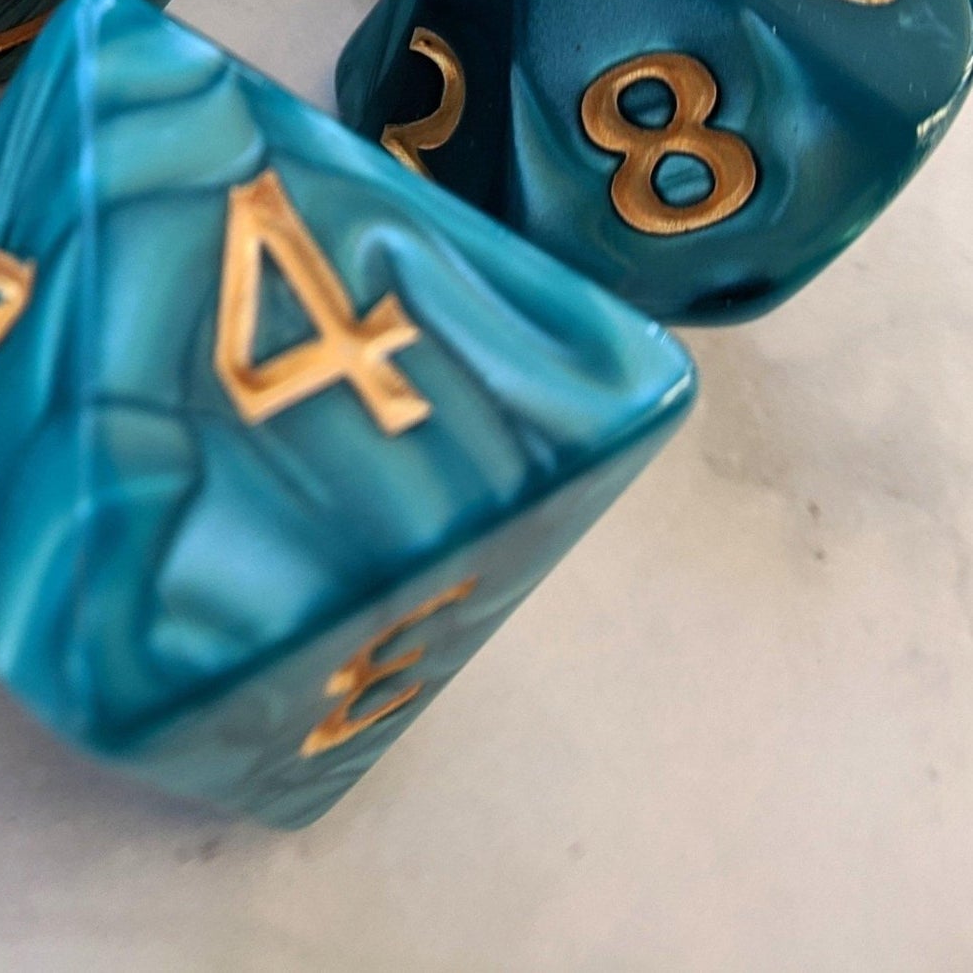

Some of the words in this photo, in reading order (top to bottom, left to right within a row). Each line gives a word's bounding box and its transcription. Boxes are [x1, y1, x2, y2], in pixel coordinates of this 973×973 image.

[580, 52, 757, 236] 8
[213, 169, 432, 435] 4
[298, 575, 478, 760] 3
